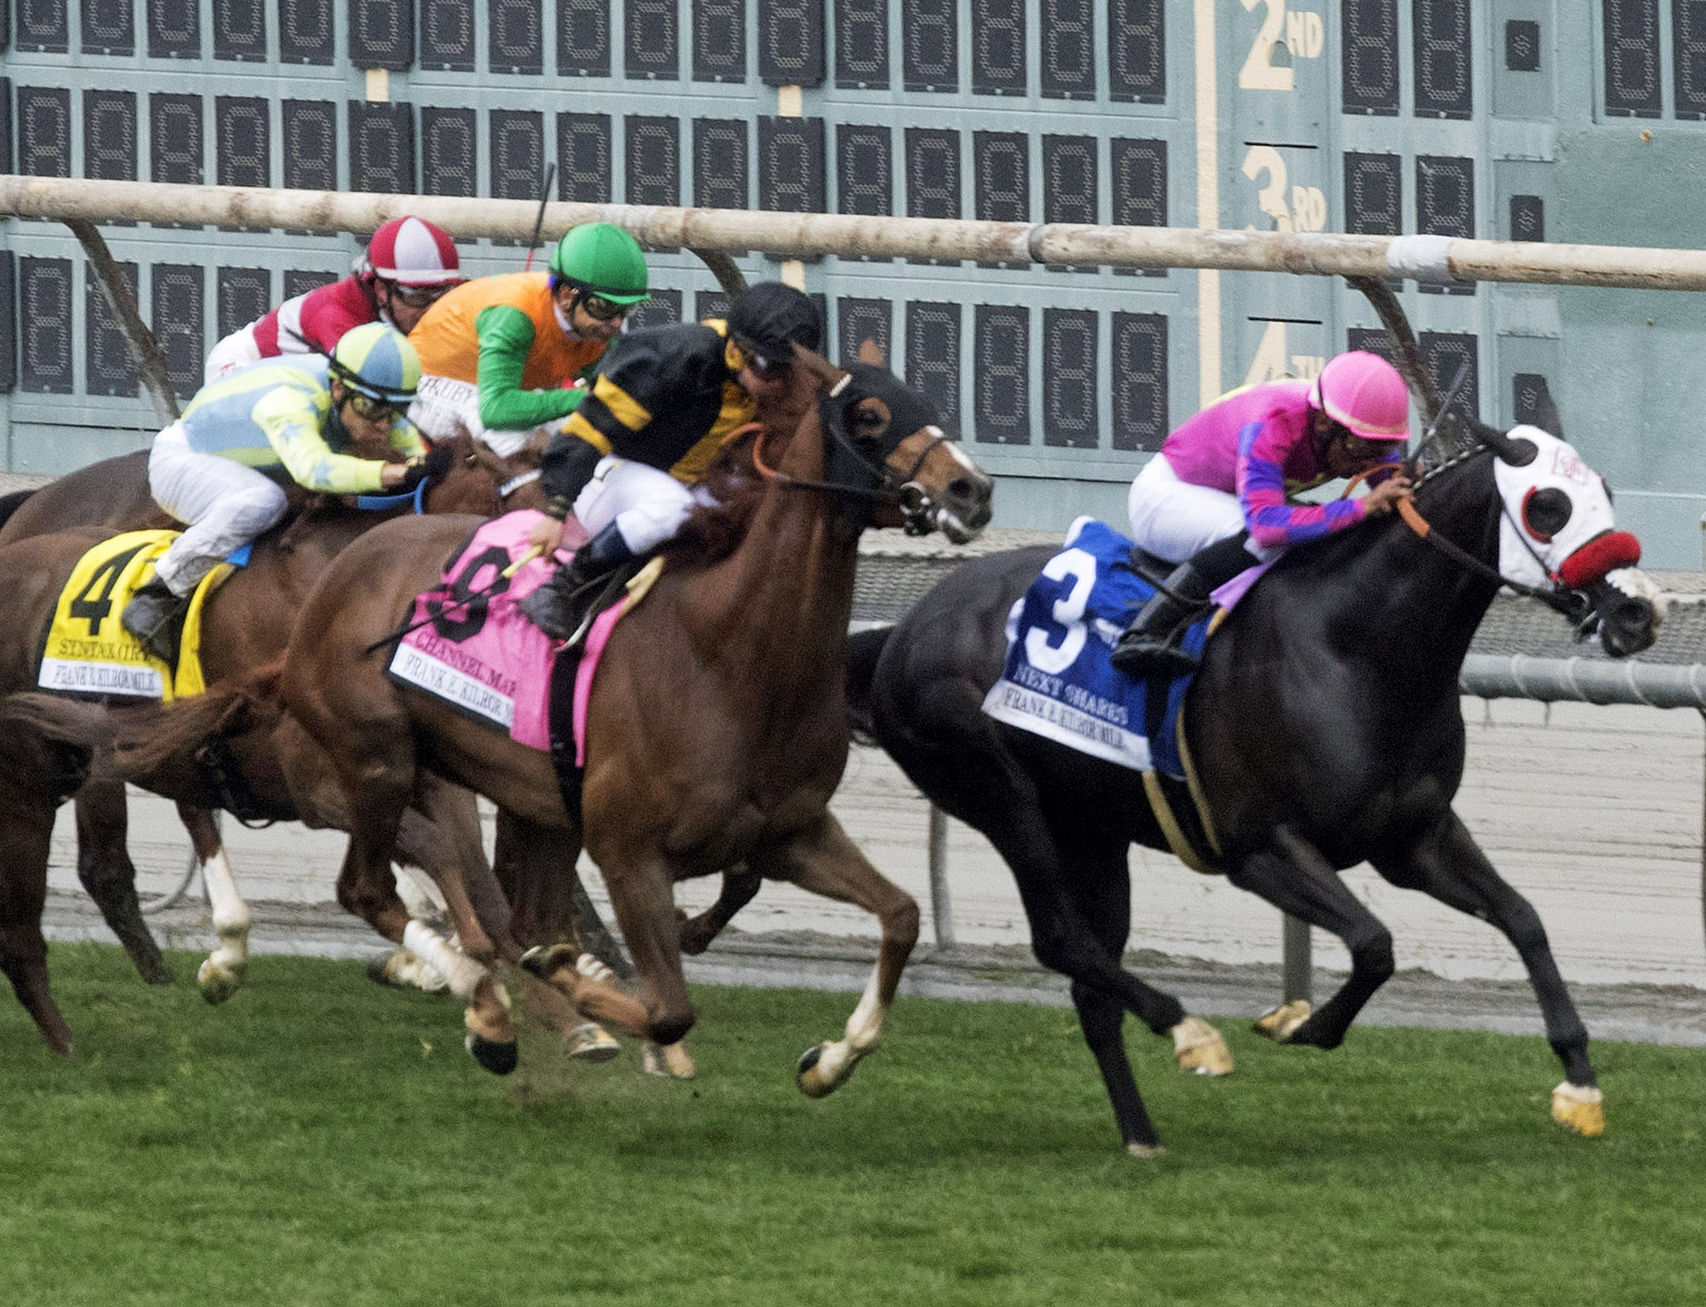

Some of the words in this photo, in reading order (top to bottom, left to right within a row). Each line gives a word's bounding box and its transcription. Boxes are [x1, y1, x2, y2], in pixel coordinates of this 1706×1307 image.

[70, 542, 154, 636] 4
[427, 546, 512, 642] 8
[1025, 547, 1097, 675] 3
[59, 638, 117, 660] SYNTAX
[403, 654, 448, 691] FRANK
[414, 630, 483, 680] CHANNEL
[1013, 663, 1065, 699] NEXT
